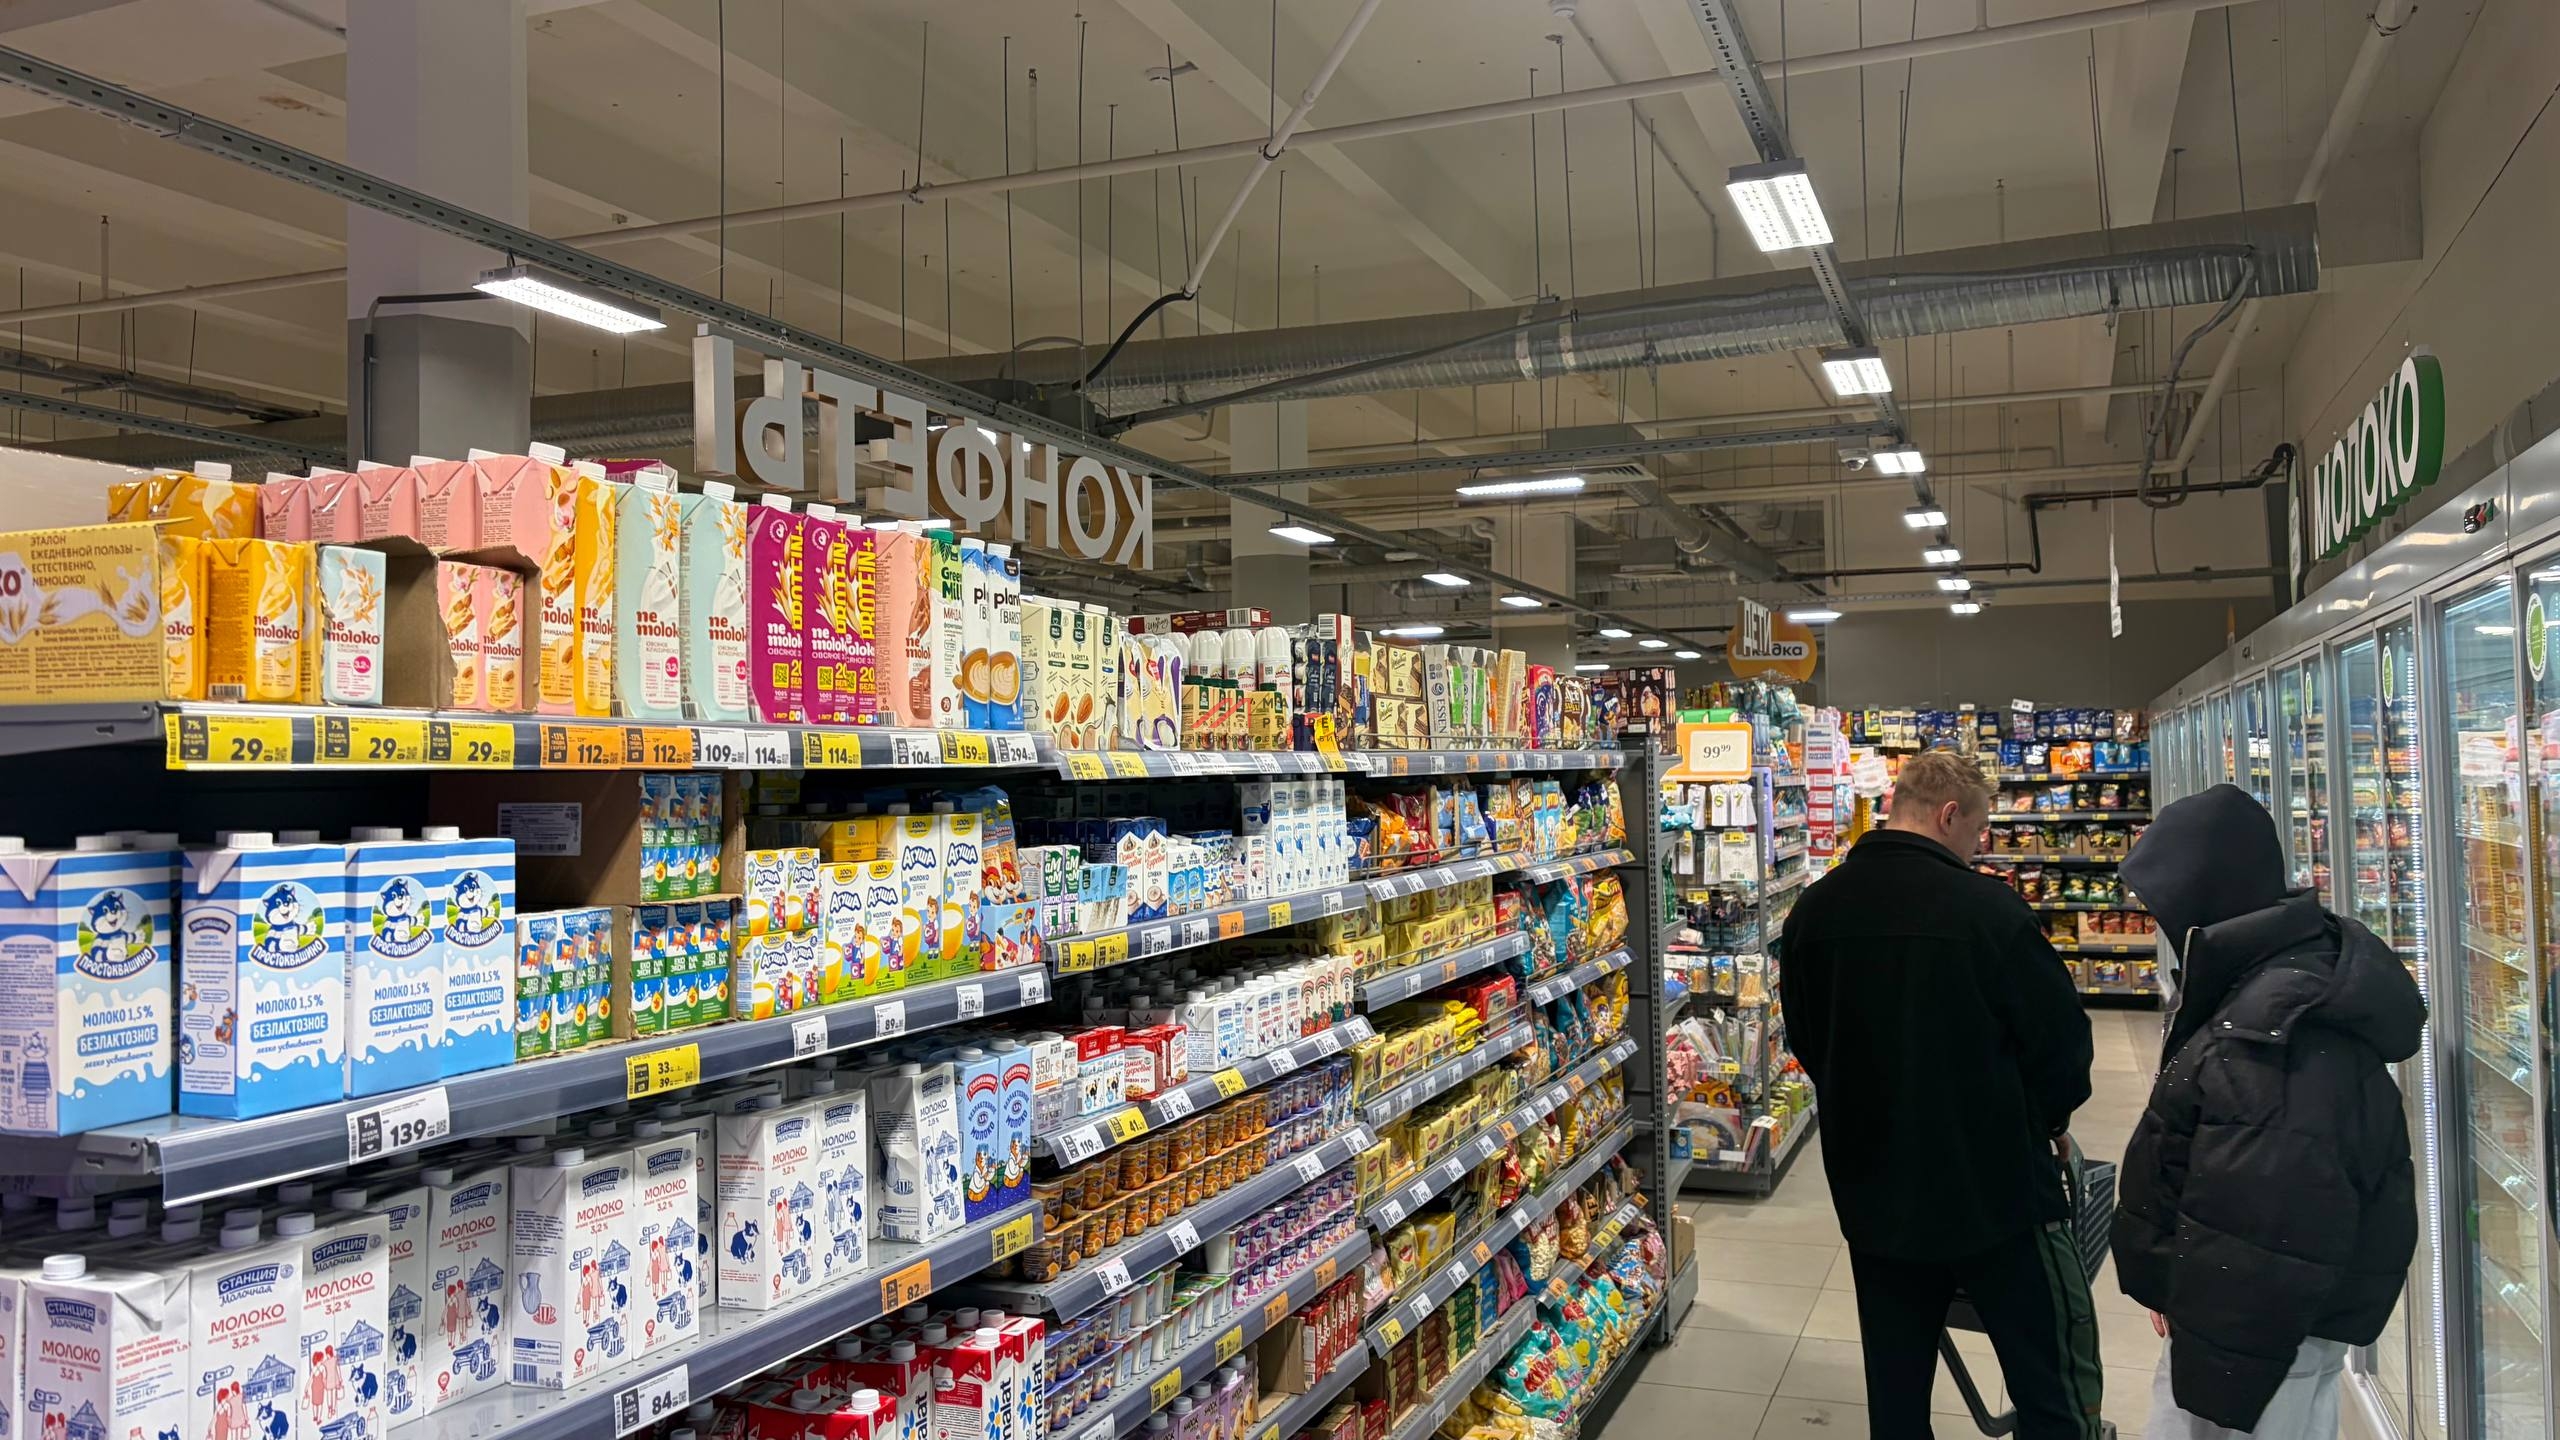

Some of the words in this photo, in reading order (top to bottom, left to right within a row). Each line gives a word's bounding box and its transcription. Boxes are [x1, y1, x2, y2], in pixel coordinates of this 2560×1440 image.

[2314, 357, 2420, 560] МОЛОКО
[31, 535, 66, 546] ЭТАЛОН
[31, 546, 93, 560] ЕЖЕДНЕВНОЙ
[95, 544, 133, 556] ПОЛЬЗЫ
[31, 560, 97, 573] ЕСТЕСТВЕННО,
[33, 574, 86, 588] NEMOLOKO!
[857, 537, 876, 640] PROTEIN+
[254, 615, 268, 626] ne
[581, 607, 598, 618] ne
[636, 610, 658, 622] ne
[708, 616, 727, 627] ne
[767, 623, 785, 635] ne
[1743, 599, 1771, 656] ДЕТИ
[253, 625, 300, 640] moloko
[327, 630, 380, 644] moloko
[483, 635, 495, 644] ne
[811, 628, 829, 639] ne
[483, 644, 521, 657] moloko
[906, 637, 920, 648] ne
[1437, 699, 1447, 733] ESSEN
[231, 738, 263, 761] 29
[368, 737, 396, 759] 29
[467, 741, 493, 762] 29
[577, 745, 603, 764] 112
[653, 745, 676, 764] 112
[705, 744, 731, 763] 109
[755, 746, 777, 764] 114
[829, 747, 848, 764] 114
[961, 745, 977, 760] 159
[1010, 747, 1027, 762] 294
[1703, 746, 1720, 758] 99
[911, 751, 930, 765] 104
[447, 922, 500, 945] ПРОСТОКВАШИНО
[1230, 922, 1238, 933] 69
[373, 933, 430, 955] ПРОСТОКВАШИНО
[1153, 941, 1164, 953] 139
[253, 939, 323, 967] ПРОСТОКВАШИНО
[1076, 953, 1086, 966] 39
[79, 948, 153, 978] ПРОСТОКВАШИНО
[449, 973, 481, 987] МОЛОКО
[374, 985, 408, 1000] МОЛОКО
[447, 989, 502, 1008] БЕЗЛАКТОЗНОЕ
[1028, 987, 1036, 997] 49
[256, 997, 297, 1014] МОЛОКО
[372, 1002, 432, 1023] БЕЗЛАКТОЗНОЕ
[964, 999, 975, 1011] 119
[83, 1009, 126, 1028] МОЛОКО
[253, 1016, 326, 1038] БЕЗЛАКТОЗНОЕ
[885, 1018, 895, 1030] 89
[80, 1028, 156, 1052] БЕЗЛАКТОЗНОЕ
[805, 1032, 816, 1045] 45
[658, 1061, 669, 1074] 33
[659, 1077, 669, 1088] 39
[920, 1099, 947, 1117] МОЛОКО
[1175, 1103, 1187, 1115] 96
[390, 1119, 426, 1147] 139
[1129, 1120, 1139, 1132] 41
[821, 1130, 856, 1148] МОЛОКО
[1079, 1139, 1094, 1155] 119
[648, 1149, 682, 1168] СТАНЦИЯ
[772, 1145, 807, 1165] МОЛОКО
[583, 1169, 619, 1188] СТАНЦИЯ
[451, 1185, 490, 1205] СТАНЦИЯ
[644, 1178, 687, 1200] МОЛОКО
[577, 1199, 623, 1223] МОЛОКО
[441, 1216, 495, 1241] МОЛОКО
[313, 1237, 366, 1261] СТАНЦИЯ
[1185, 1236, 1194, 1247] 34
[219, 1268, 276, 1292] СТАНЦИЯ
[306, 1272, 373, 1302] МОЛОКО
[1113, 1274, 1122, 1286] 39
[907, 1285, 920, 1301] 82
[47, 1301, 95, 1321] СТАНЦИЯ
[211, 1304, 284, 1336] МОЛОКО
[42, 1340, 101, 1364] МОЛОКО
[652, 1390, 672, 1415] 84
